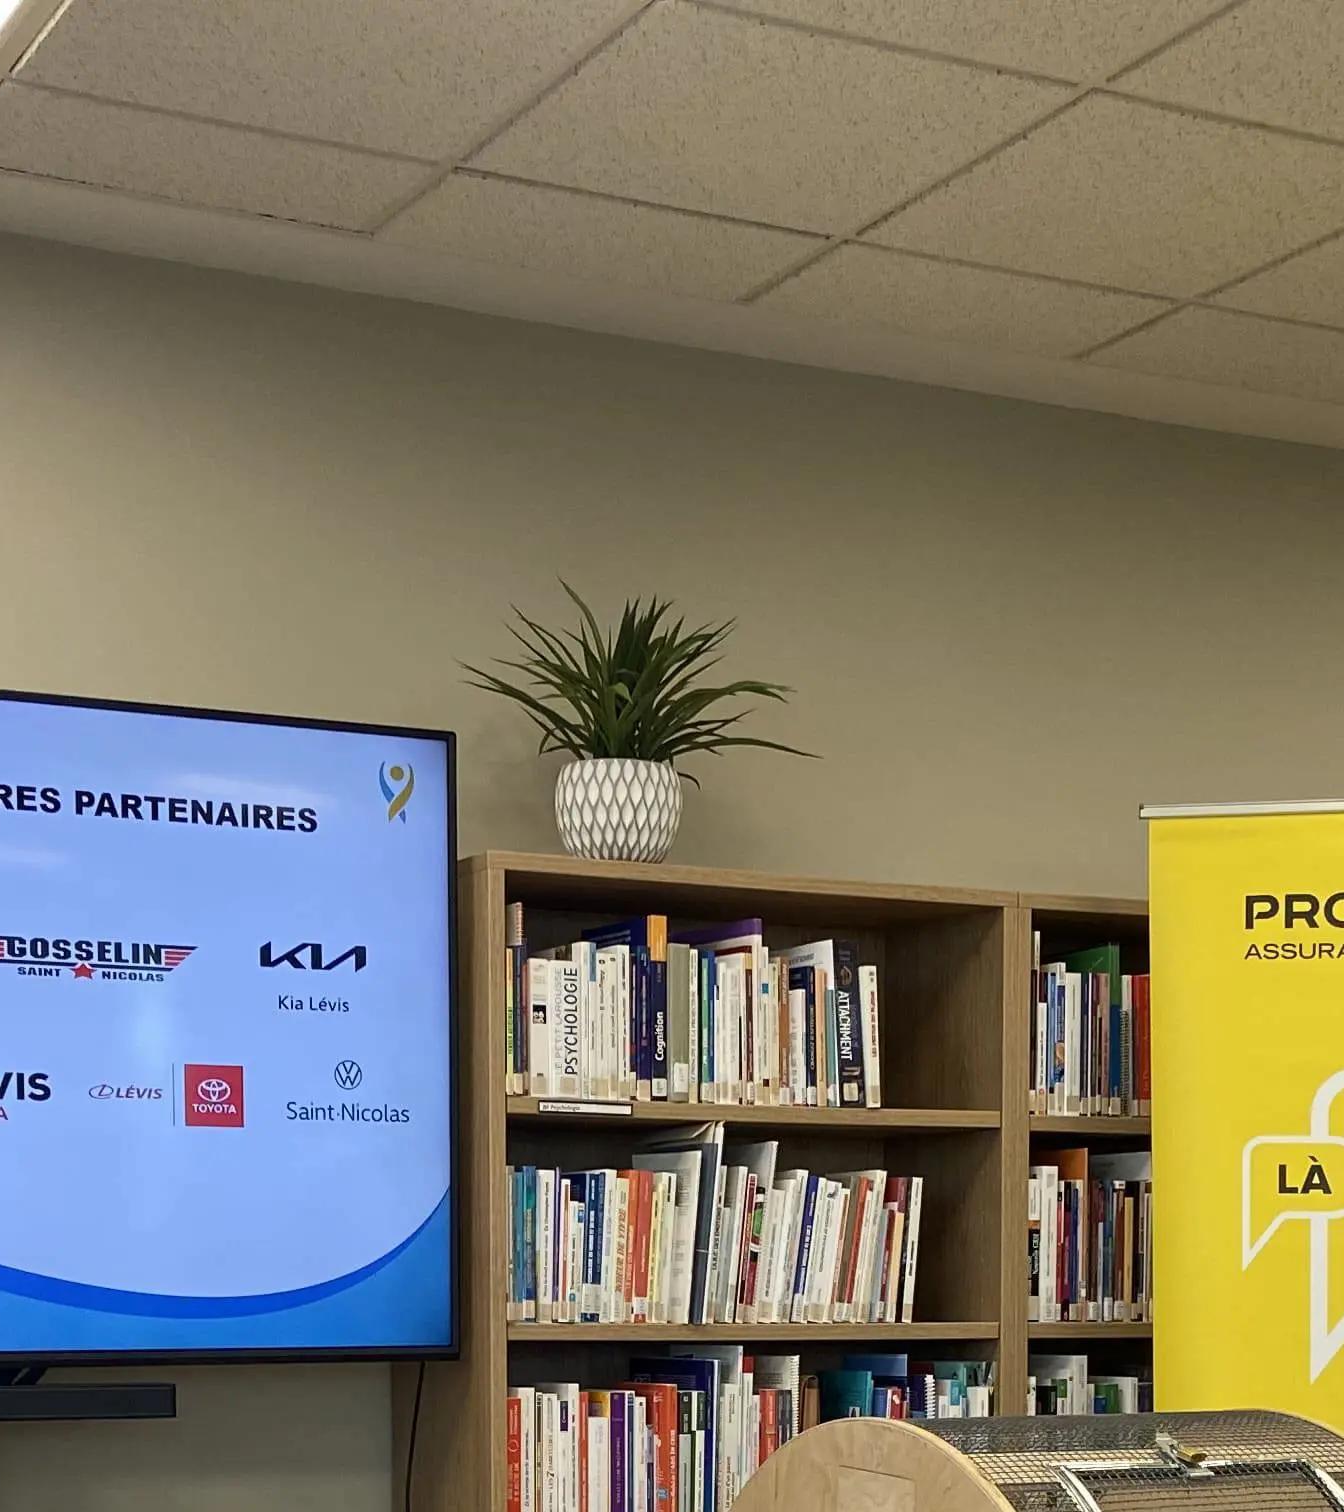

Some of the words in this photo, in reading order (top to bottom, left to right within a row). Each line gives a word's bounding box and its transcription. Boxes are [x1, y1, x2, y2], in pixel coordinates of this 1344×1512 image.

[74, 790, 318, 833] PARTENAIRES
[6, 936, 162, 965] GOSSELIN
[17, 966, 61, 977] SAINT
[102, 970, 164, 983] NICOLAS
[278, 995, 304, 1012] Kia
[309, 995, 350, 1013] Lévis
[564, 967, 578, 1075] PSYCHOLOGIE
[655, 1012, 665, 1061] Cognition
[837, 990, 853, 1060] ATTACHMENT
[116, 1085, 163, 1099] LÉVIS
[192, 1104, 236, 1114] TOYOTA
[1277, 1155, 1332, 1195] LÀ
